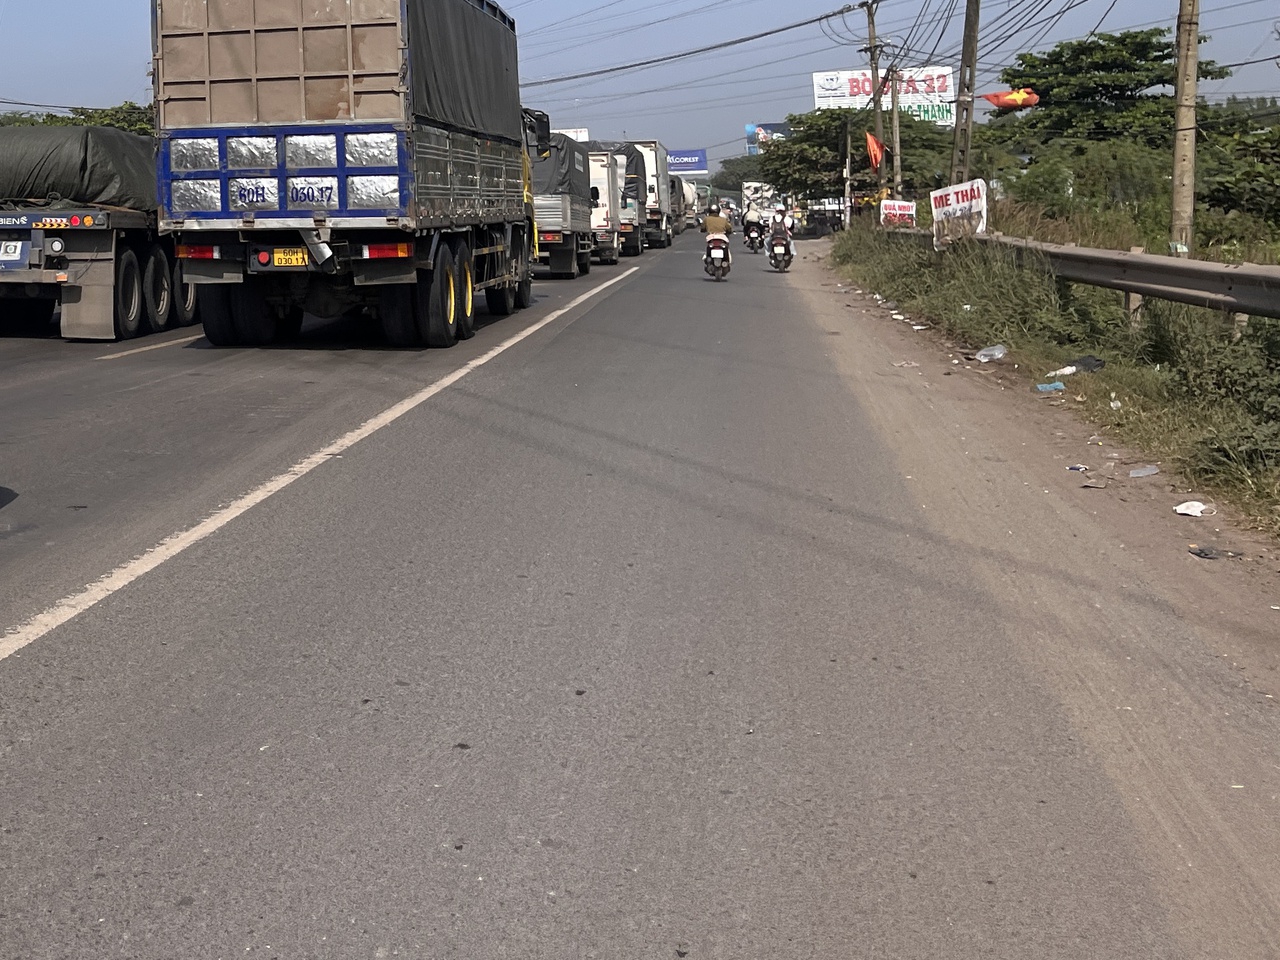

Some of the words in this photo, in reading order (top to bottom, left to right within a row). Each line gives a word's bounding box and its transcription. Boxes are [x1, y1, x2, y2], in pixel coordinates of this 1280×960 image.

[924, 74, 948, 93] 22
[239, 186, 265, 203] 60H
[291, 186, 333, 203] 030.17
[283, 248, 298, 257] 60H
